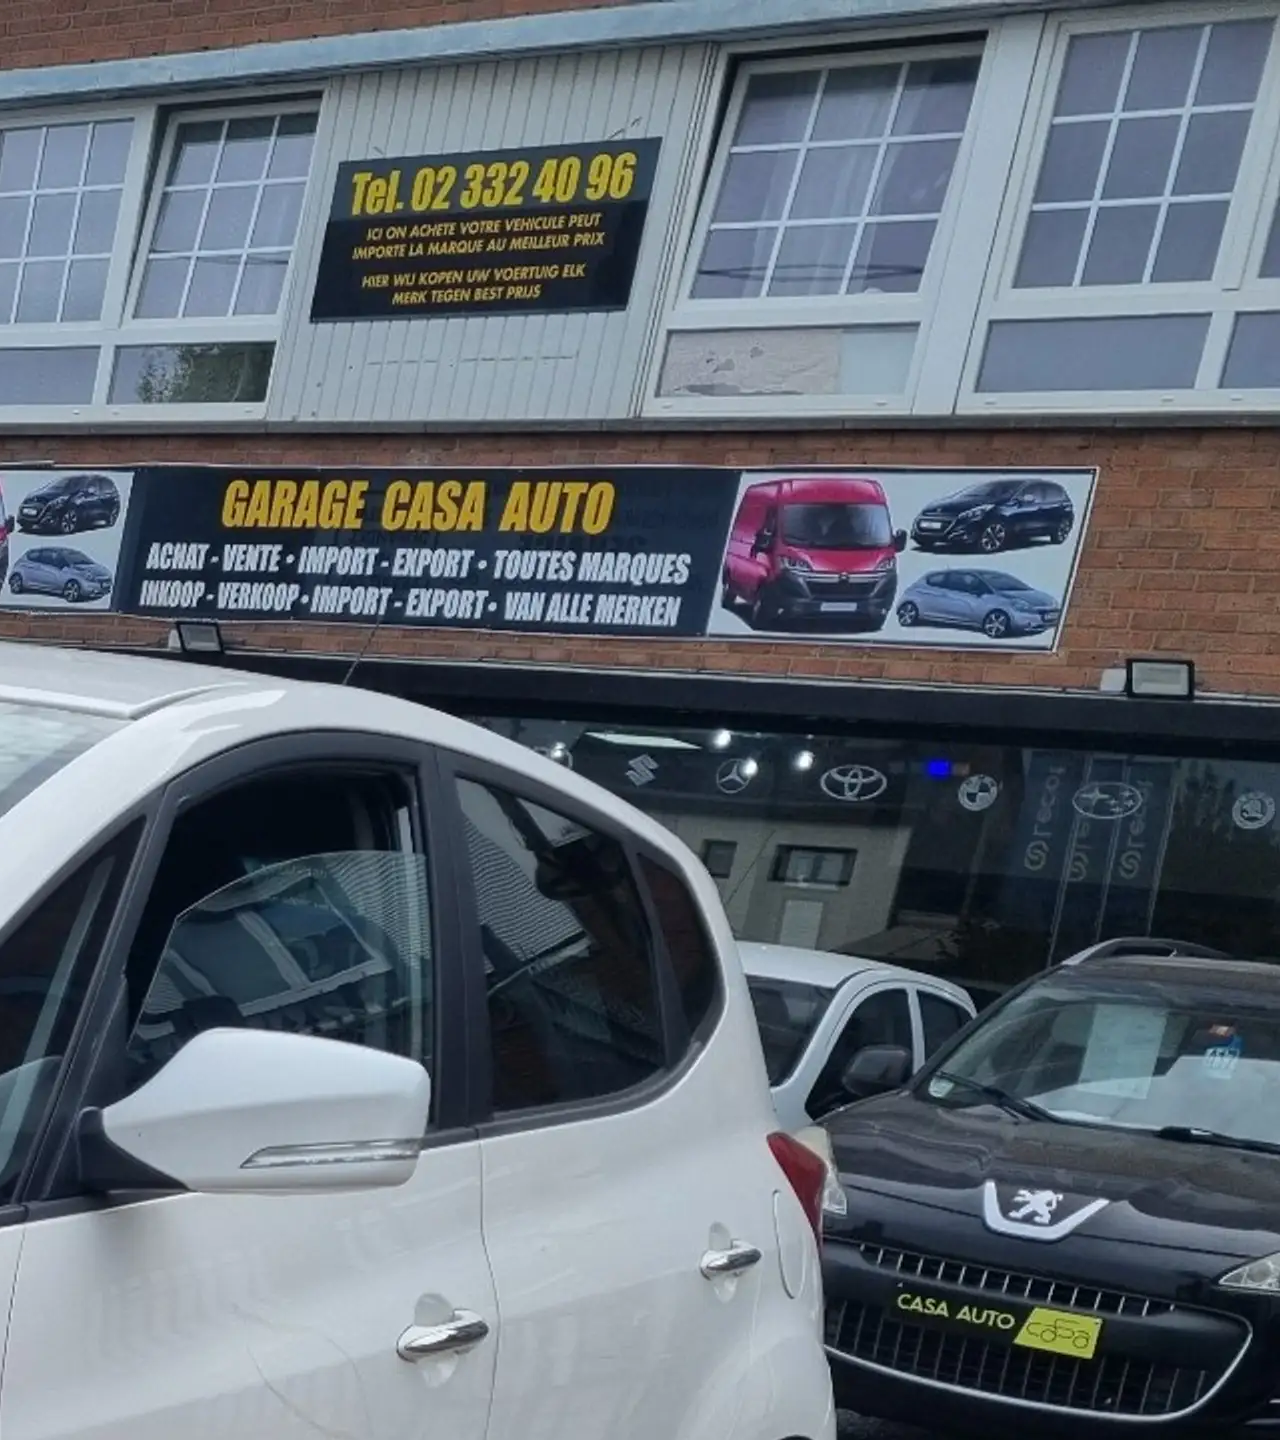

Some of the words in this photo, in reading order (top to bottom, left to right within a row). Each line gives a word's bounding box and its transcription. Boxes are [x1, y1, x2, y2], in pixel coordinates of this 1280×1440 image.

[351, 170, 404, 216] Tel.
[411, 166, 457, 212] 02
[460, 160, 530, 208] 332
[532, 156, 581, 203] 40
[585, 152, 637, 201] 96
[366, 227, 383, 241] ICI
[385, 225, 408, 240] ON
[460, 219, 501, 235] VOTRE
[505, 215, 565, 232] VEHICULE
[568, 212, 602, 228] PEUT
[351, 243, 407, 260] IMPORTE
[408, 242, 424, 257] LA
[426, 239, 483, 256] MARQUE
[486, 238, 506, 252] AU
[509, 234, 569, 251] MEILLEUR
[573, 231, 606, 247] PRIX
[361, 274, 390, 288] HIER
[418, 269, 464, 286] KOPEN
[466, 268, 492, 283] UW
[561, 263, 587, 278] ELK
[391, 291, 427, 306] MERK
[430, 287, 473, 303] TEGEN
[474, 286, 504, 301] BEST
[222, 480, 369, 529] GARAGE
[380, 479, 486, 532] CASA
[498, 480, 616, 534] AUTO
[145, 541, 210, 571] ACHAT
[222, 543, 283, 573] VENTE
[297, 545, 380, 576] IMPORT
[391, 548, 475, 578] EXPORT
[493, 550, 577, 581] TOUTES
[578, 552, 691, 585] MARQUES
[138, 580, 206, 608] INKOOP
[218, 582, 300, 612] VERKOOP
[311, 585, 393, 616] IMPORT
[404, 588, 489, 619] EXPORT
[503, 592, 546, 621] VAN
[545, 593, 592, 624] ALLE
[593, 595, 680, 627] MERKEN
[897, 1293, 948, 1317] CASA
[956, 1305, 1015, 1330] AUTO
